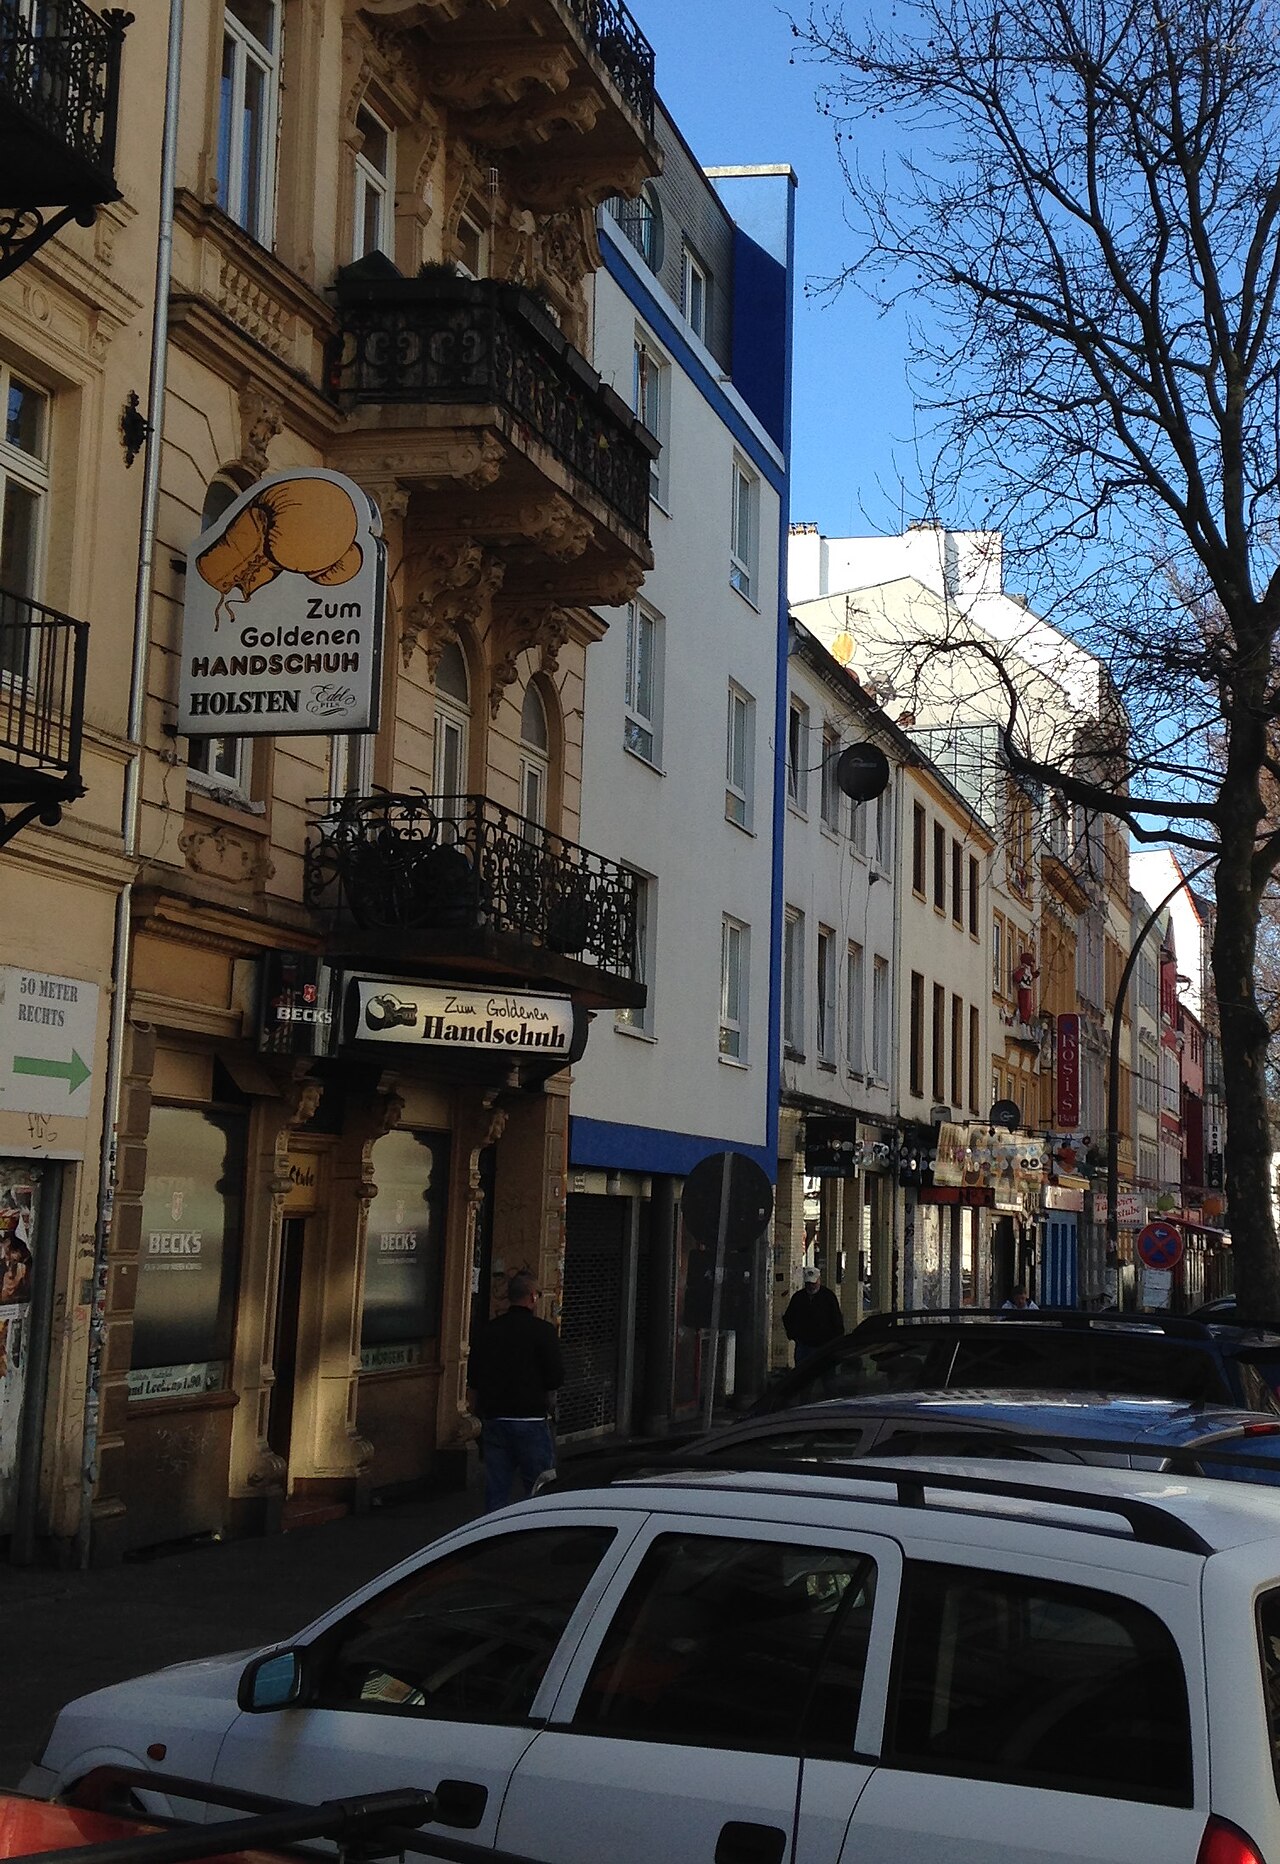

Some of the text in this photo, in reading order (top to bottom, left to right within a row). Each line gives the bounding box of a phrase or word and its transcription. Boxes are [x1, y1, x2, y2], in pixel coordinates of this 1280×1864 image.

[306, 598, 361, 619] Zum
[240, 626, 360, 648] Goldenen
[191, 652, 359, 678] HANDSCHUH
[189, 689, 301, 717] HOLSTEN
[311, 684, 352, 703] Edel
[20, 977, 78, 1002] 50 METER
[18, 1003, 65, 1027] RECHTS
[445, 996, 549, 1021] Zum Goldenen
[421, 1015, 566, 1048] Handschuh
